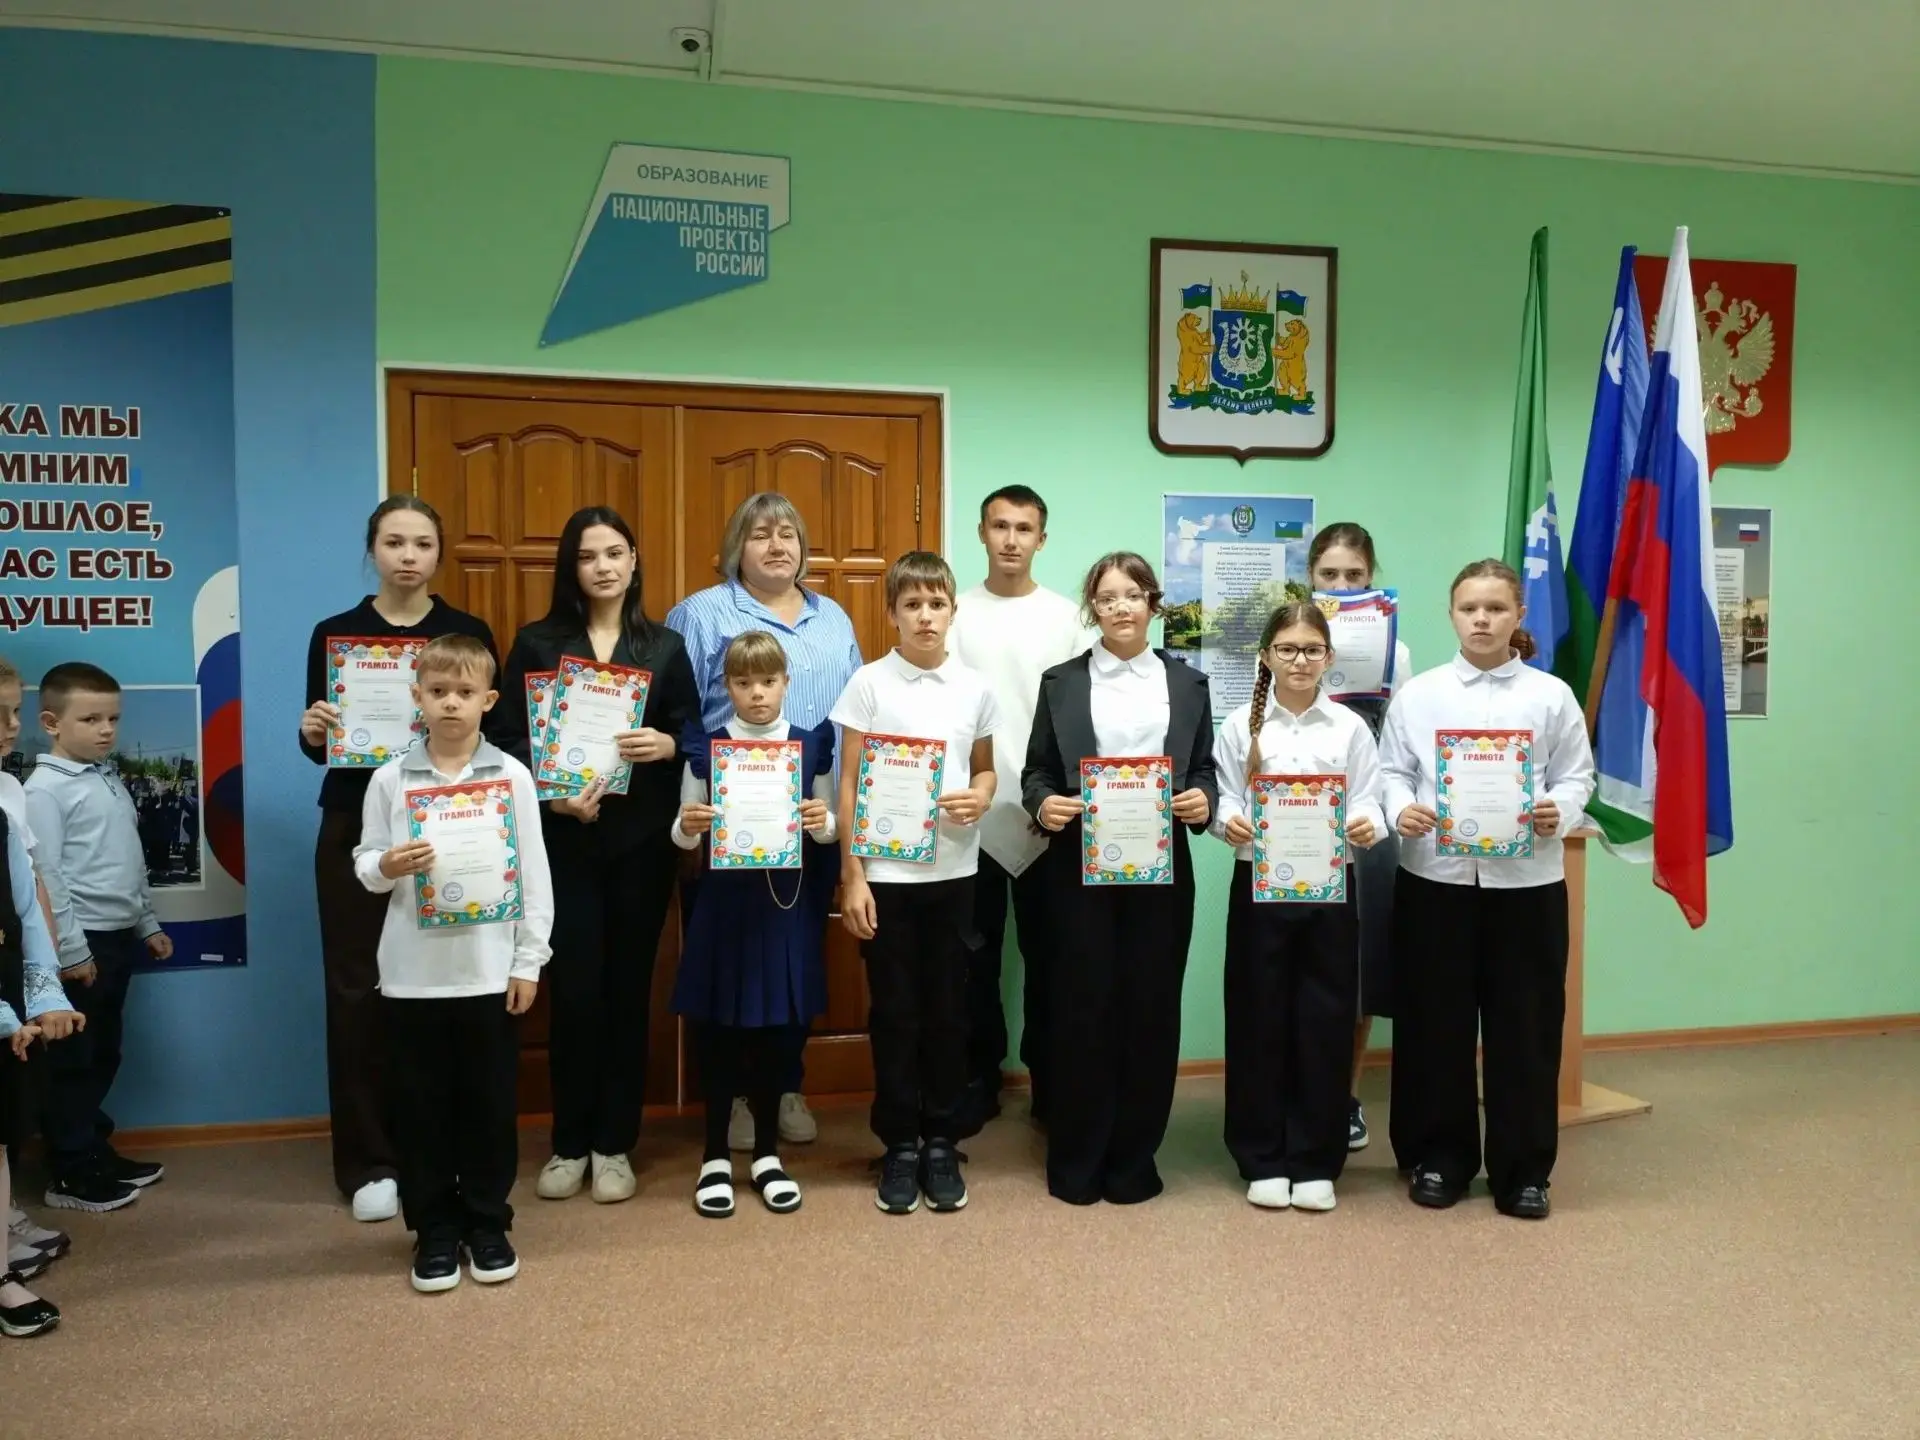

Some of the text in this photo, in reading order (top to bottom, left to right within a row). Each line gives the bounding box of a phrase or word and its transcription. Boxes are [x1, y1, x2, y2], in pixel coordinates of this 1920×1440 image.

[637, 164, 769, 189] ОБРАЗОВАНИЕ
[612, 197, 765, 229] НАЦИОНАЛЬНЫЕ
[679, 226, 765, 253] ПРОЕКТЫ
[695, 252, 765, 277] РОССИИ
[60, 404, 141, 439] МЫ
[68, 548, 174, 581] ЕСТЬ
[1339, 615, 1377, 623] ГРАМОТА
[356, 661, 399, 670] ГРАМОТА
[582, 683, 621, 697] ГРАМОТА
[884, 757, 920, 769] ГРАМОТА
[1463, 753, 1505, 761] ГРАМОТА
[737, 763, 777, 772] ГРАМОТА
[1106, 781, 1147, 790] ГРАМОТА
[1278, 798, 1319, 807] ГРАМОТА
[438, 808, 485, 821] ГРАМОТА
